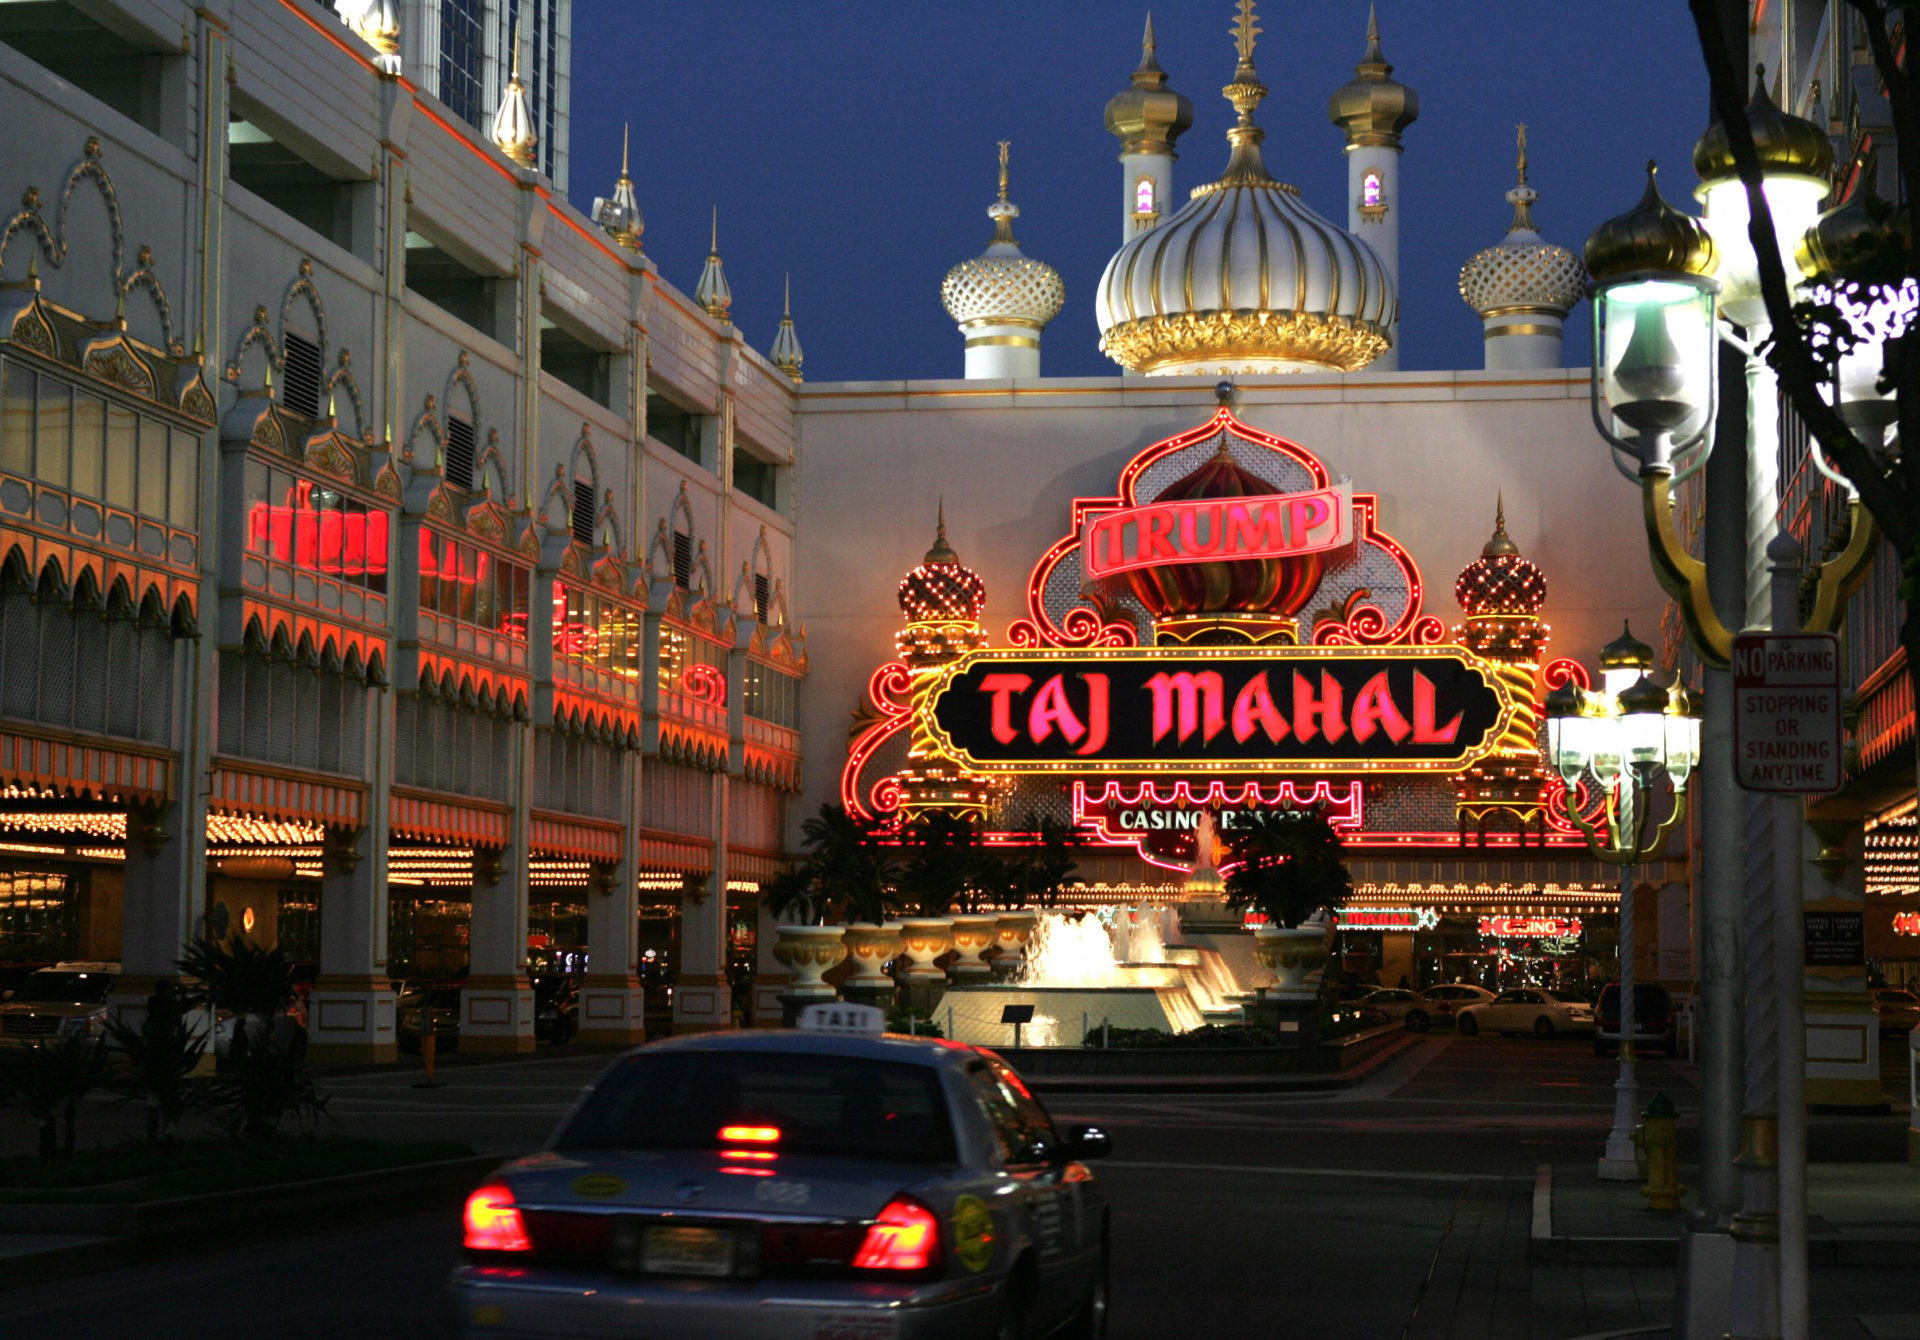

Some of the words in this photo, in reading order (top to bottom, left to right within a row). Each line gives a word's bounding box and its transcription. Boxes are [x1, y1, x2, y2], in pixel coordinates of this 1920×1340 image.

[1099, 497, 1330, 566] TRUMP
[1735, 647, 1765, 678] NO
[1768, 651, 1832, 672] PARKING
[977, 671, 1110, 756] TAJ
[1140, 667, 1465, 748] MAHAL
[1746, 695, 1828, 713] STOPPING
[1776, 719, 1799, 736] OR
[1746, 741, 1829, 759] STANDING
[1752, 764, 1825, 782] ANYTIME
[1502, 921, 1557, 933] CASINO
[815, 1009, 868, 1027] TAXI
